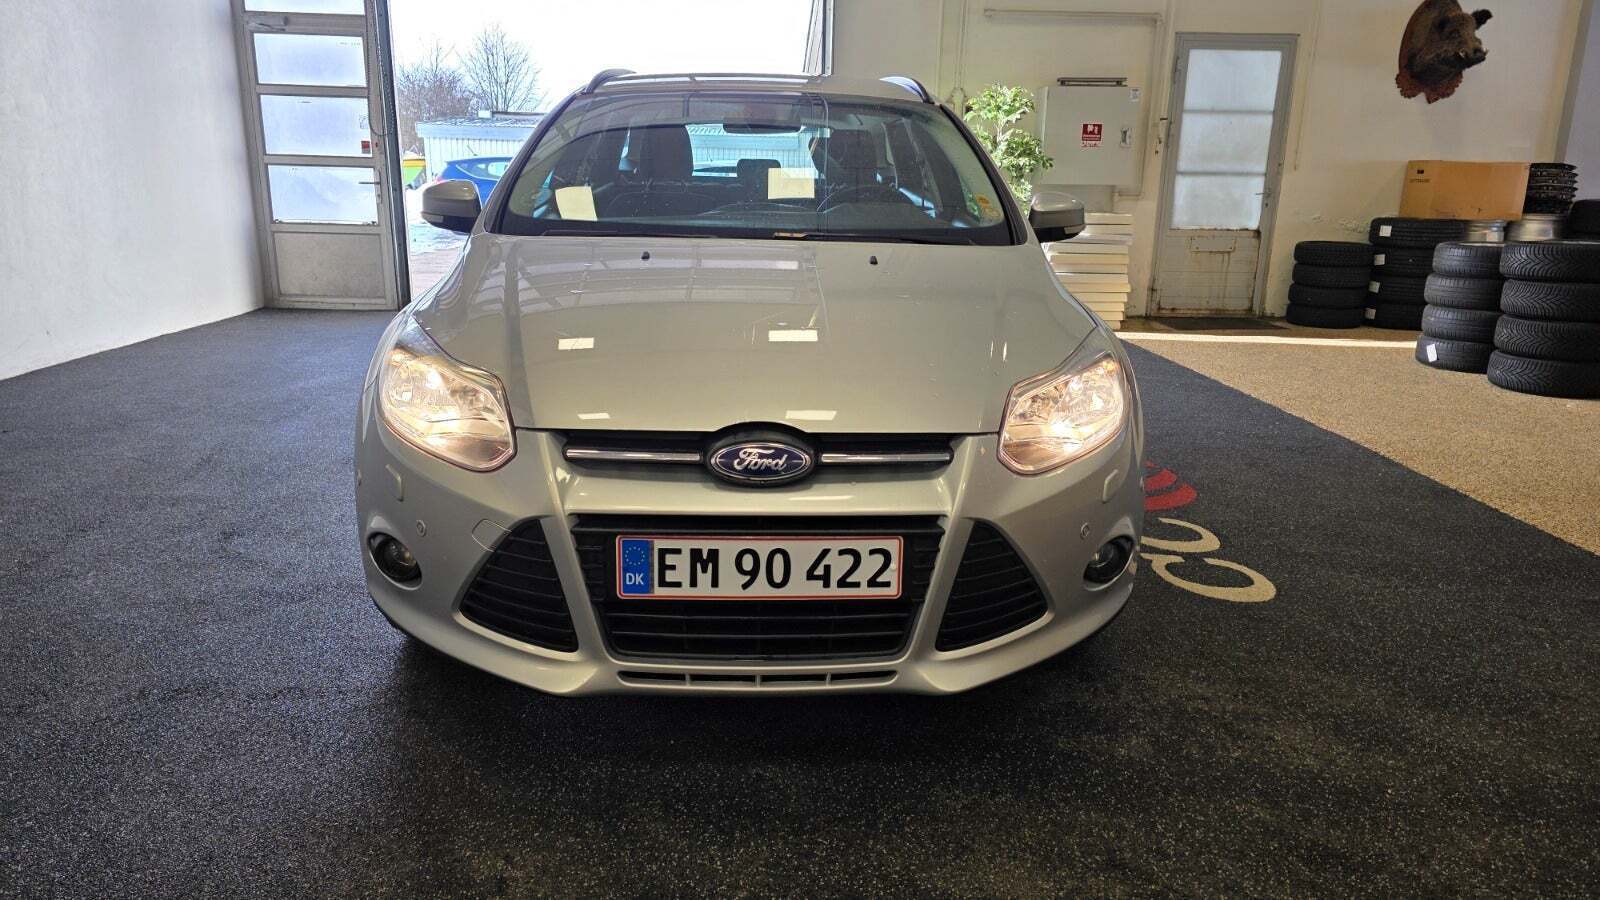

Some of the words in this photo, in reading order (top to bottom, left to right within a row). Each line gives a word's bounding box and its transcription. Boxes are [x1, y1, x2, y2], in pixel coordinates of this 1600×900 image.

[734, 448, 788, 470] Ford
[625, 573, 644, 585] DK
[658, 548, 719, 588] EM
[735, 548, 791, 590] 90
[806, 548, 892, 588] 422
